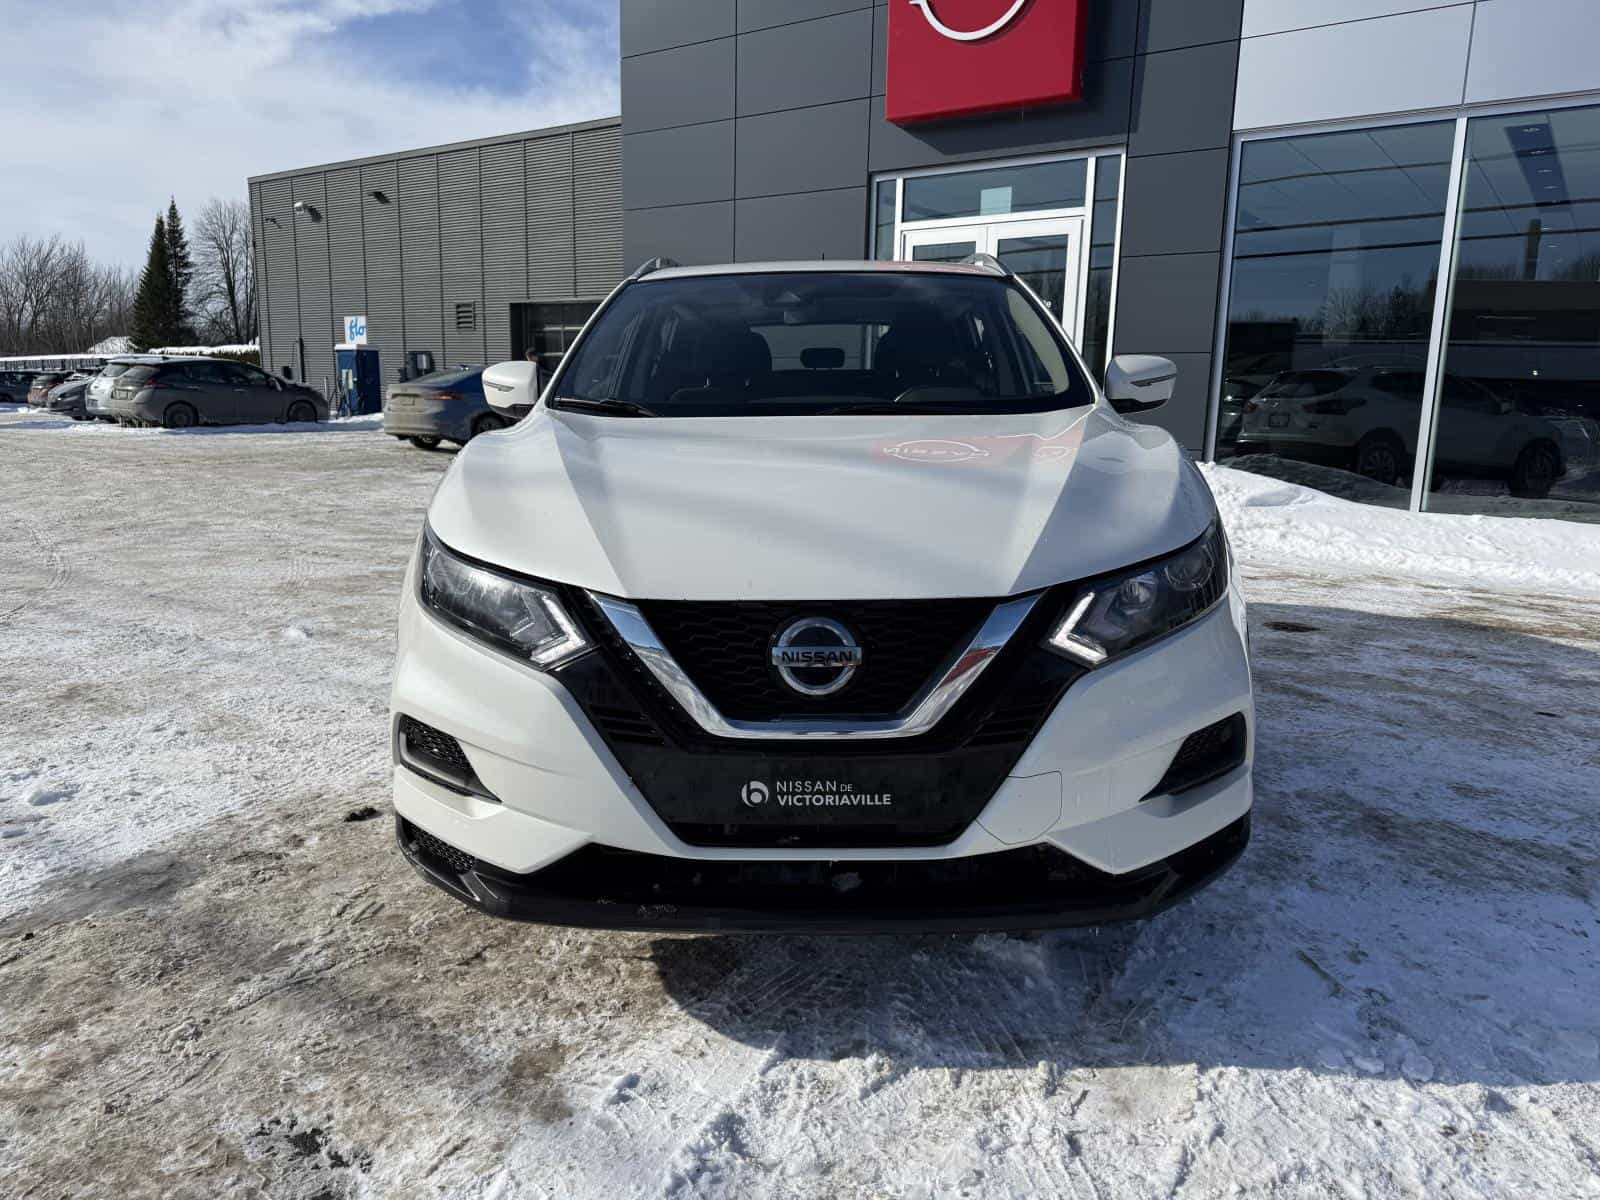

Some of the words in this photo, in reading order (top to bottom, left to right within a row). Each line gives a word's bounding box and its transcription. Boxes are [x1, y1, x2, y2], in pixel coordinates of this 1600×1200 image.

[349, 317, 366, 341] flo
[781, 650, 853, 664] NISSAN
[776, 780, 837, 792] NISSAN
[840, 783, 853, 792] DE
[777, 794, 892, 806] VICTORIAVILLE
